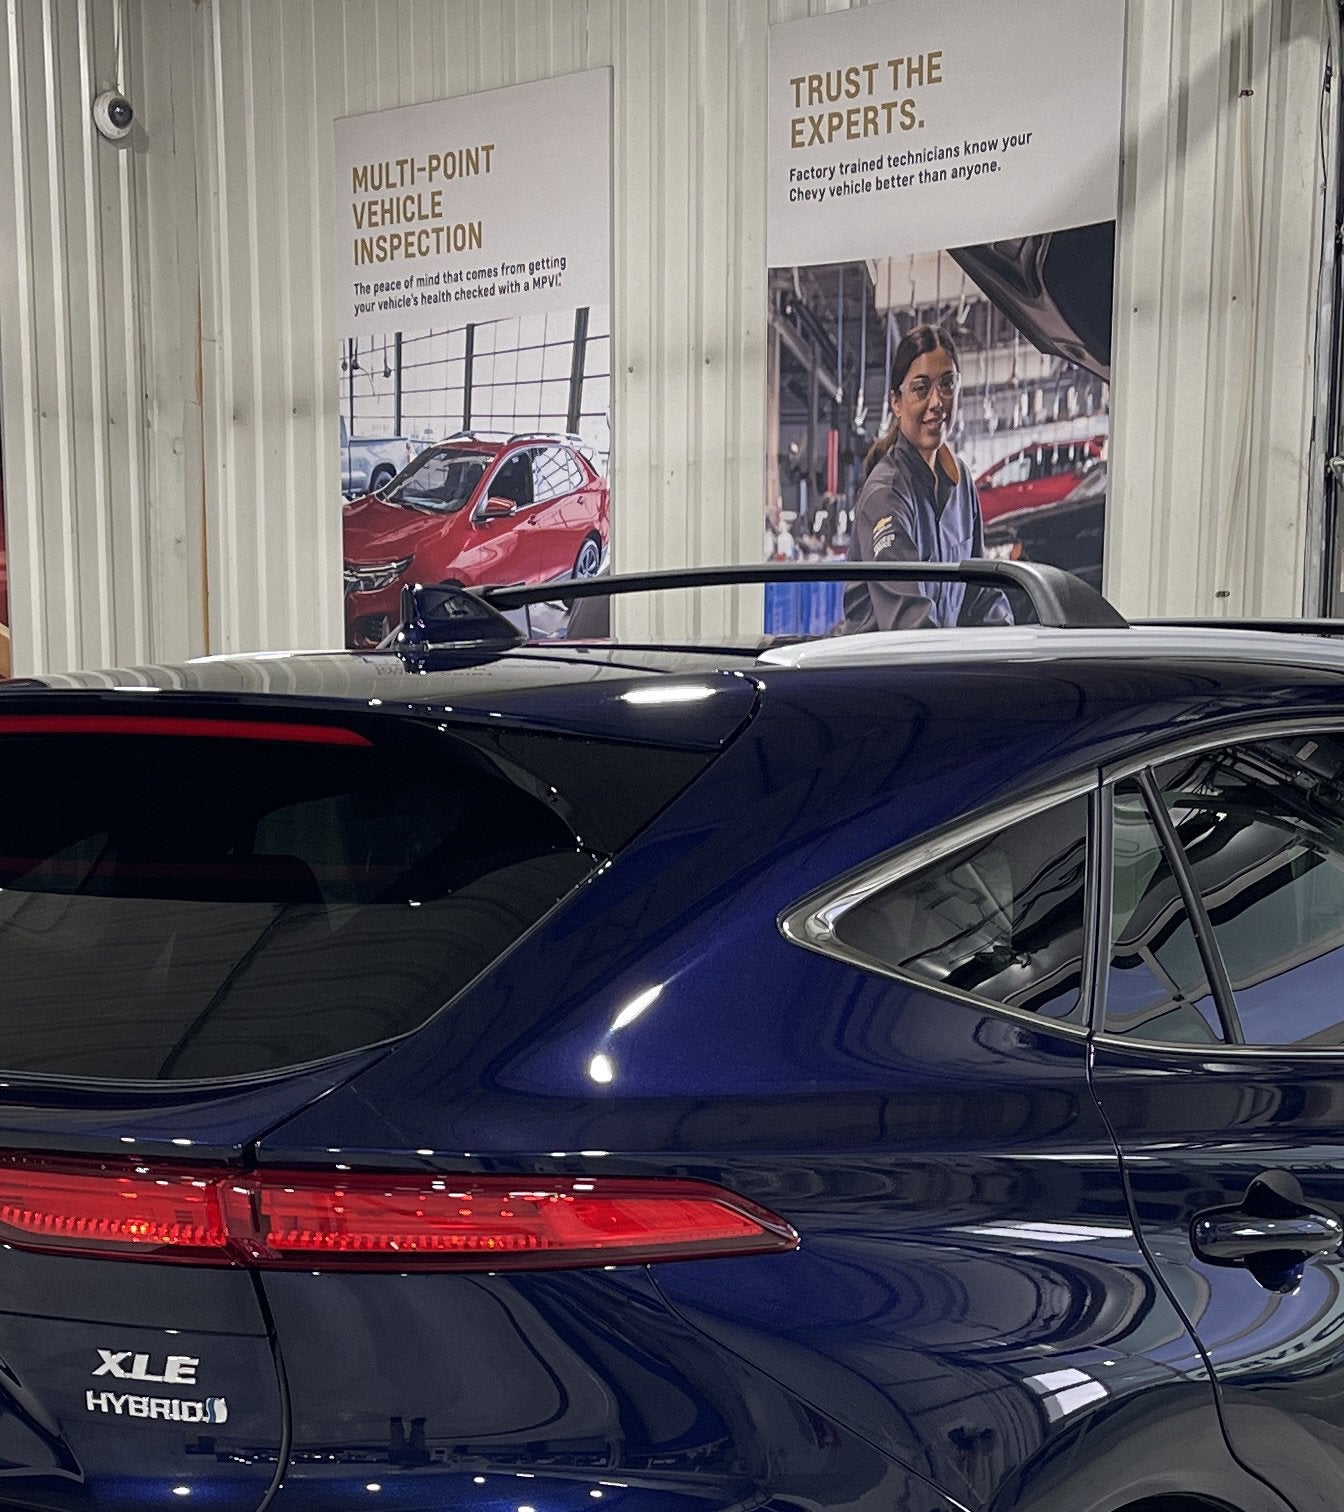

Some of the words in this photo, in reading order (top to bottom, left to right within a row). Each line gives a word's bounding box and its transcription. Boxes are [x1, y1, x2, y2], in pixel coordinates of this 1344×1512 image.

[789, 63, 879, 108] TRUST
[887, 50, 943, 92] THE
[791, 98, 925, 149] EXPERTS.
[352, 144, 495, 194] MULTI-POINT
[789, 165, 836, 182] Factory
[839, 154, 884, 176] trained
[887, 144, 960, 169] technicians
[963, 138, 999, 156] know
[1002, 132, 1033, 153] your
[789, 186, 826, 203] Chevy
[829, 177, 872, 198] vehicle
[875, 174, 915, 192] better
[919, 168, 947, 184] than
[951, 160, 1002, 180] anyone.
[352, 190, 443, 230] VEHICLE
[354, 221, 483, 266] INSPECTION
[354, 282, 371, 296] The
[373, 279, 402, 298] peace
[404, 274, 414, 290] of
[416, 271, 440, 288] mind
[443, 270, 464, 284] that
[466, 266, 499, 281] comes
[501, 262, 526, 277] from
[528, 255, 567, 276] getting
[354, 301, 376, 317] your
[378, 293, 419, 311] vehicle's
[421, 288, 452, 306] health
[454, 282, 496, 302] checked
[498, 280, 521, 296] with
[523, 281, 530, 292] a
[91, 1348, 199, 1385] XLE
[85, 1389, 205, 1423] HYBRID
